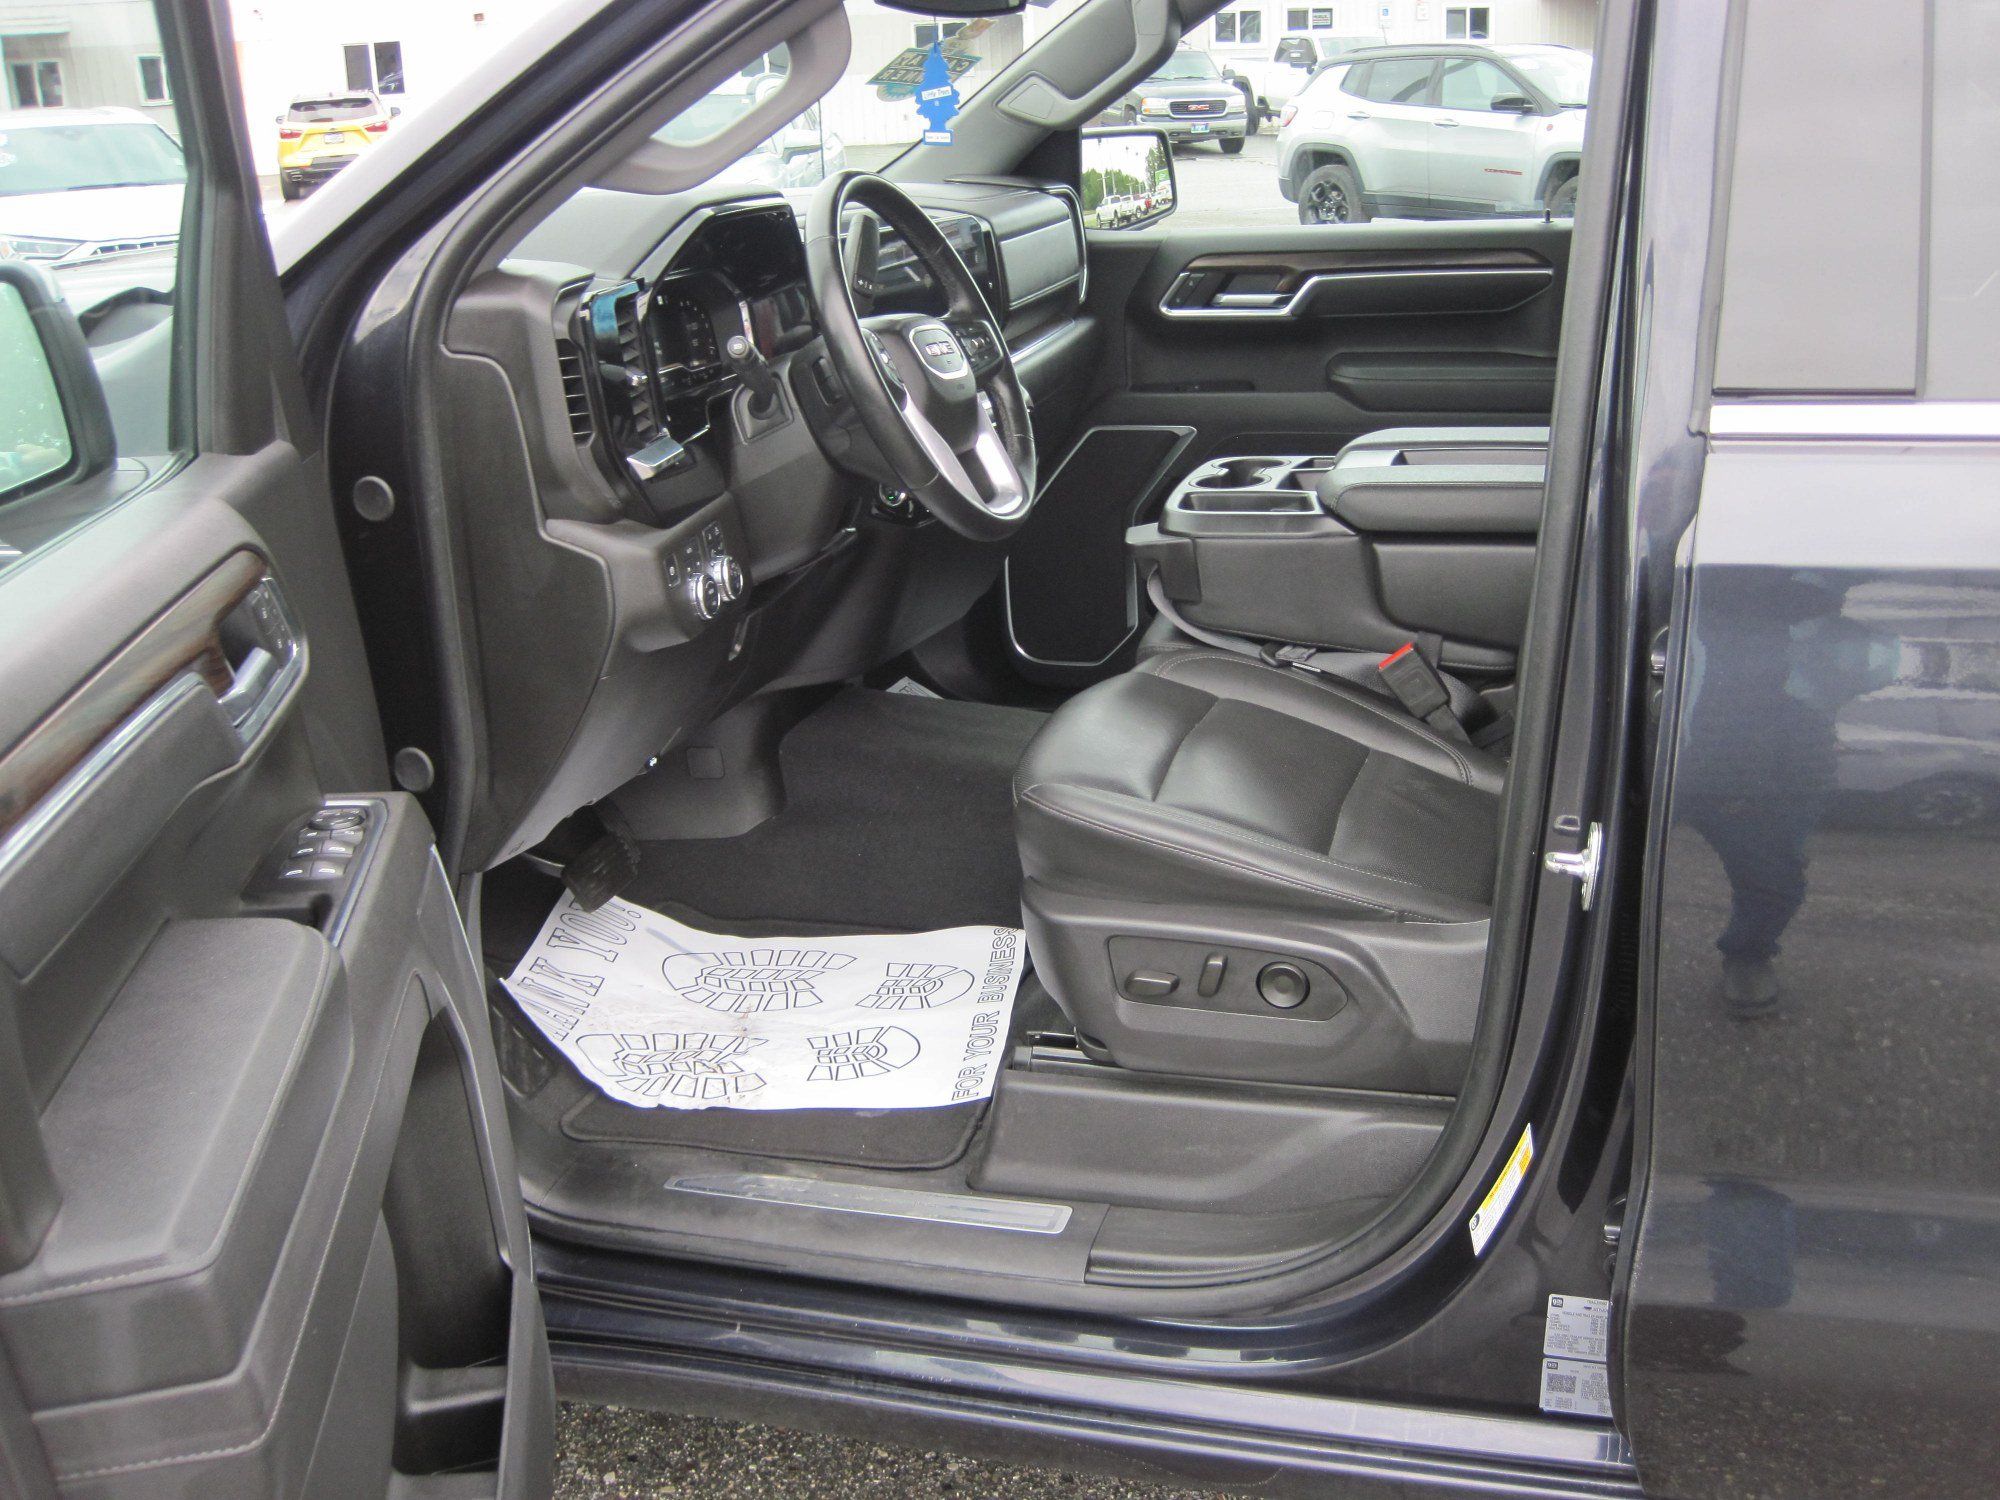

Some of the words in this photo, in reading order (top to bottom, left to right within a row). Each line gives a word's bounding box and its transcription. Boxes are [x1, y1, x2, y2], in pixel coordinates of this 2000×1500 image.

[925, 340, 955, 356] GMC
[977, 927, 1018, 1004] BUSINESS
[963, 1010, 1000, 1061] YOUR
[951, 1063, 987, 1101] FOR
